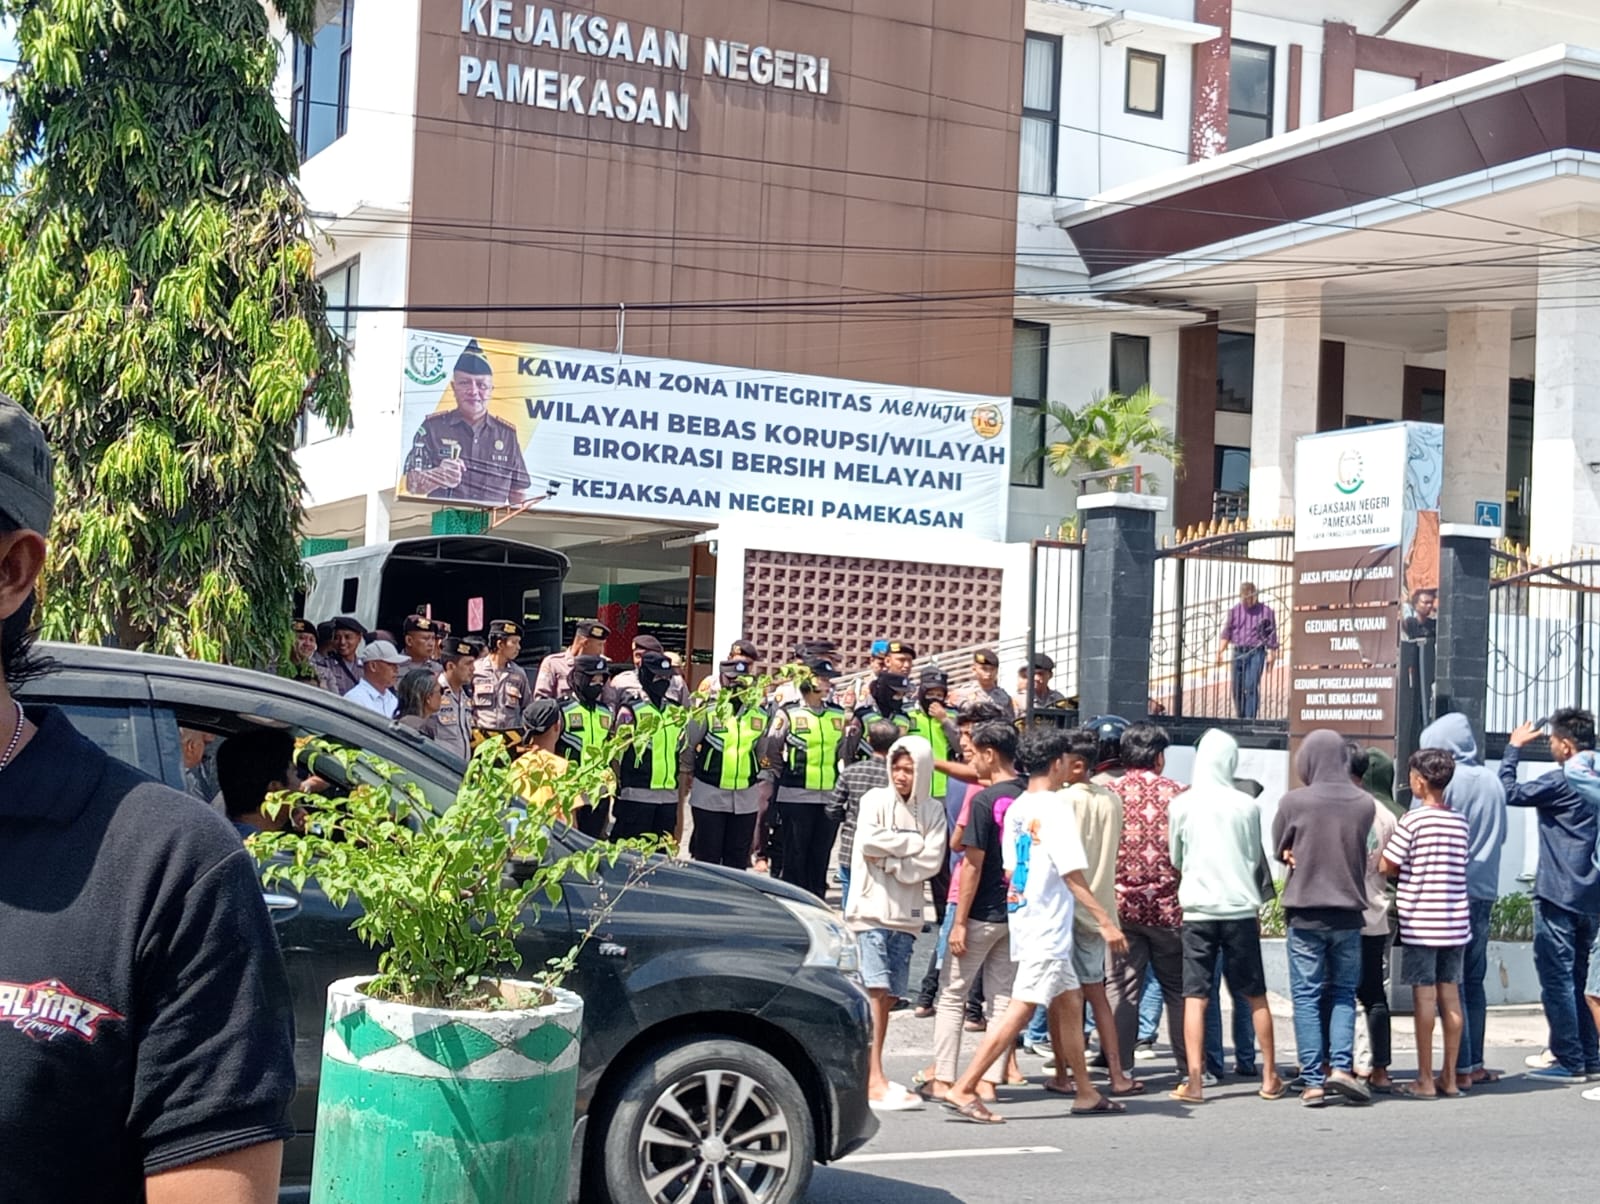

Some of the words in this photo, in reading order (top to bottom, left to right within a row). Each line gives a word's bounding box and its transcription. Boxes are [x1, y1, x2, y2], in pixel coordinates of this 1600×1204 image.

[461, 0, 689, 71] KEJAKSAAN
[704, 37, 830, 95] NEGERI
[458, 54, 689, 131] PAMEKASAN
[516, 356, 651, 389] KAWASAN
[659, 372, 728, 398] ZONA
[736, 381, 872, 412] INTEGRITAS
[525, 398, 658, 431] WILAYAH
[667, 413, 756, 440] BEBAS
[765, 423, 1005, 465] KORUPSI/WILAYAH
[573, 436, 722, 469] BIROKRASI
[732, 452, 825, 479] BERSIH
[834, 462, 962, 491] MELAYANI
[572, 478, 720, 508] KEJAKSAAN
[729, 490, 813, 517] NEGERI
[821, 502, 963, 529] PAMEKASAN
[1309, 500, 1357, 516] KEJAKSAAN
[1359, 496, 1390, 511] NEGERI
[1323, 513, 1374, 528] PAMEKASAN
[1300, 571, 1320, 584] JAKSA
[1304, 619, 1338, 633] GEDUNG
[1339, 617, 1386, 632] PELAYANAN
[1330, 637, 1360, 651] TILANG
[1294, 678, 1318, 690] GEDUNG
[1319, 677, 1364, 690] PENGELOLAAN
[1328, 692, 1351, 705] BENDA
[1352, 692, 1377, 705] SITAAN
[1301, 709, 1315, 720] DAN
[1344, 708, 1382, 720] RAMPASAN
[13, 1013, 68, 1042] Group
